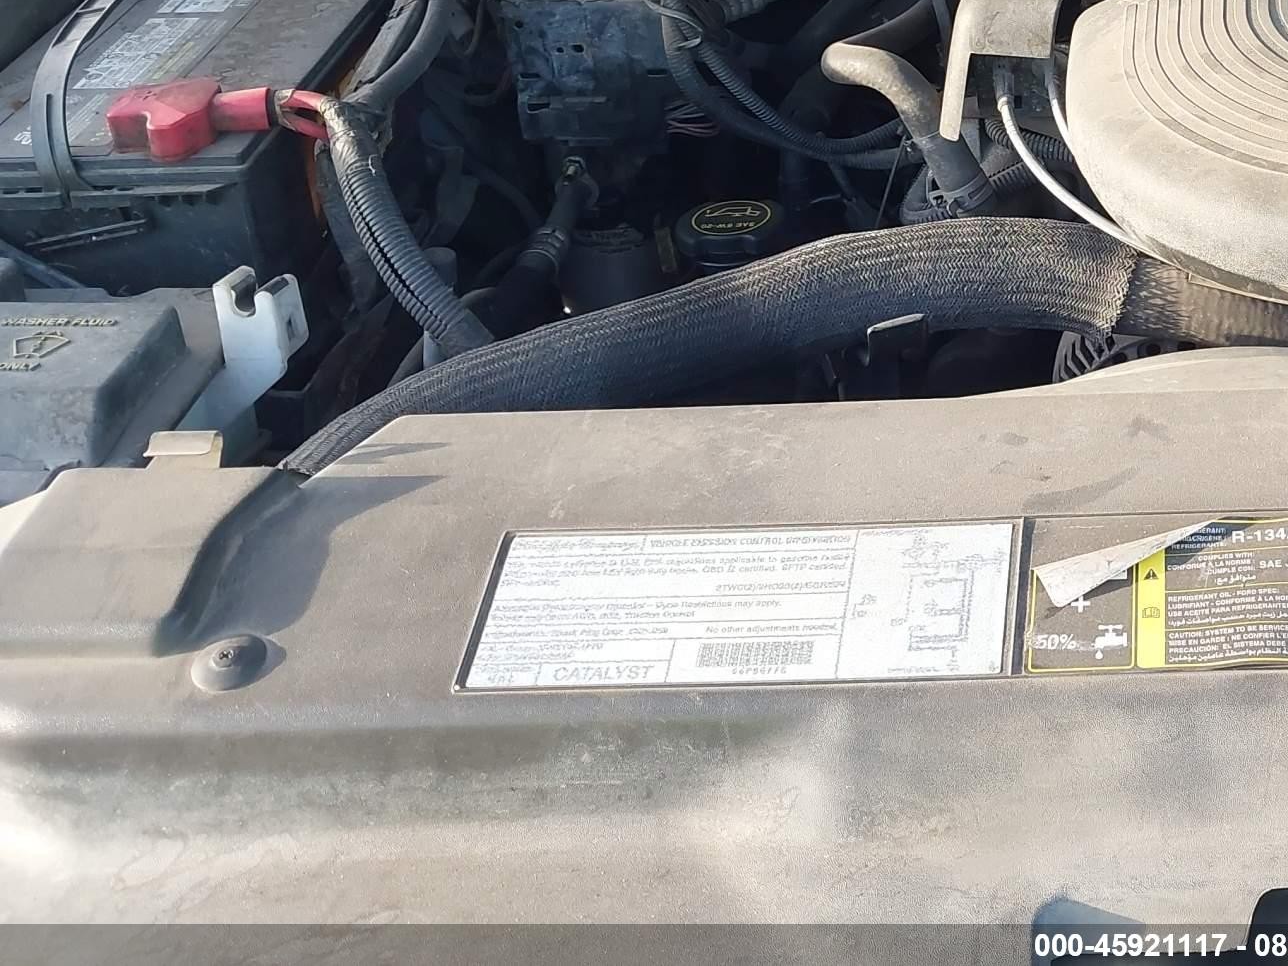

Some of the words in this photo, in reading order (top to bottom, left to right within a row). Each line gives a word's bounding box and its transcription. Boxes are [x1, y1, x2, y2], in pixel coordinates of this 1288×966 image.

[1, 317, 70, 326] WASHER
[72, 317, 118, 326] FLUID
[0, 362, 41, 372] ONLY
[740, 537, 783, 546] CONTROL
[1259, 559, 1283, 569] SAE
[1168, 593, 1217, 602] REFRIGERANT
[721, 625, 744, 633] other
[1035, 634, 1076, 650] 50%
[553, 665, 655, 682] CATALYST
